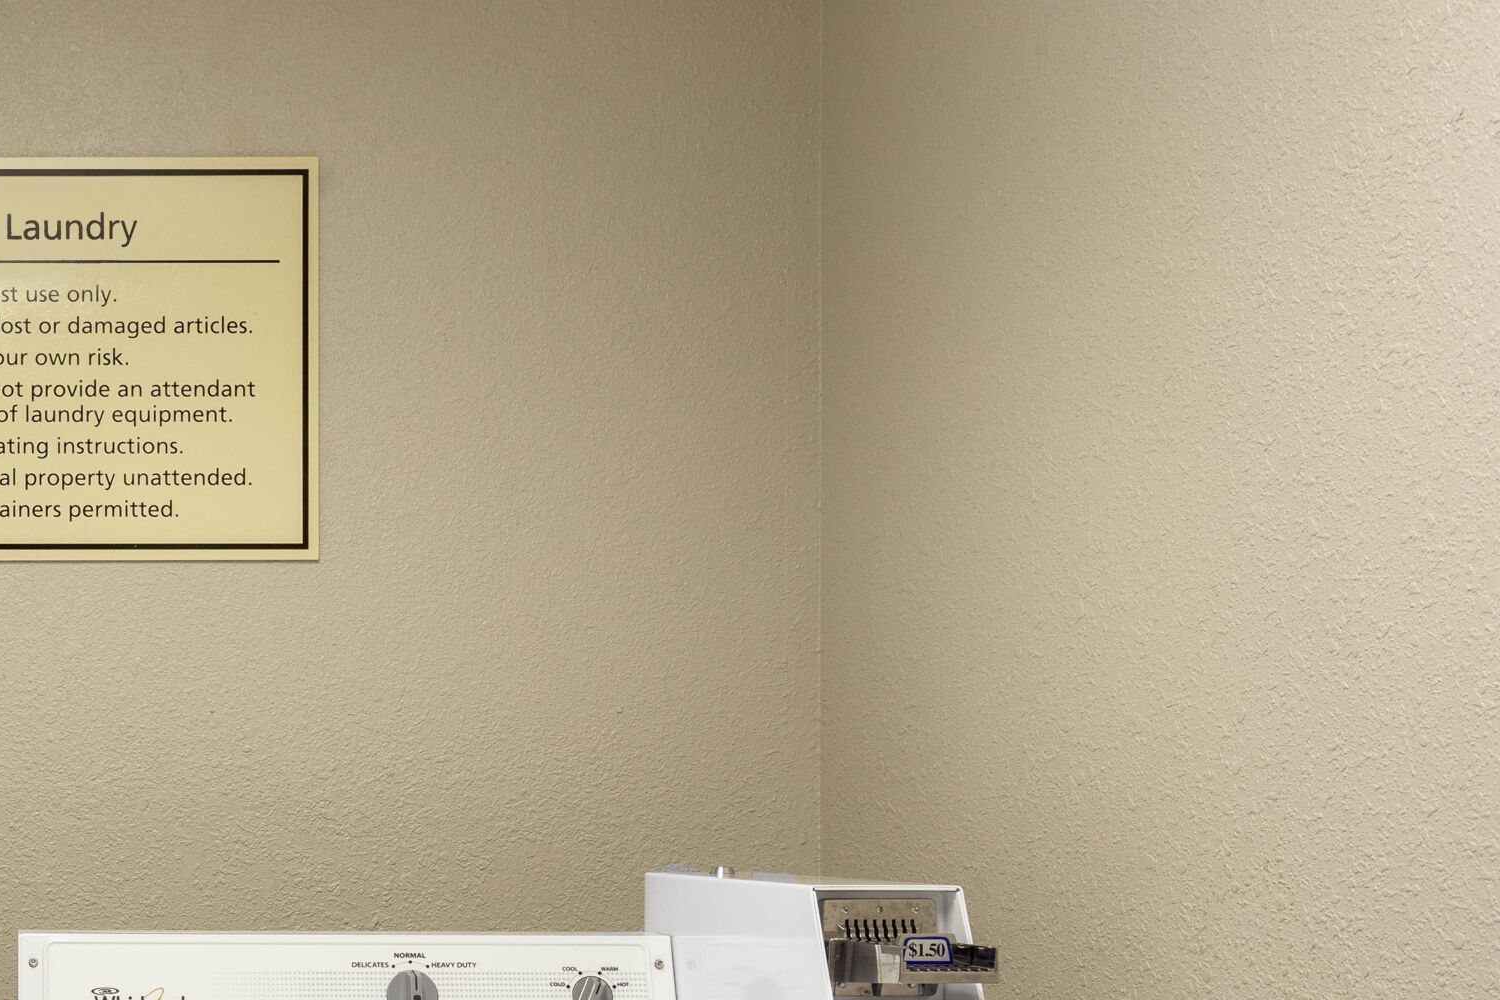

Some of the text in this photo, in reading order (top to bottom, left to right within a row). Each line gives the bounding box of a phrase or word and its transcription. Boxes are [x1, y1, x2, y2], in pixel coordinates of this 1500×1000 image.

[6, 211, 138, 248] Laundry
[25, 289, 60, 303] use
[66, 283, 117, 308] only.
[38, 320, 61, 335] or
[67, 315, 166, 340] damaged
[173, 315, 253, 335] articles.
[34, 352, 80, 366] own
[88, 346, 130, 367] risk.
[30, 378, 111, 403] provide
[117, 383, 143, 398] an
[150, 378, 256, 398] attendant
[25, 403, 105, 428] laundry
[111, 404, 233, 428] equipment.
[56, 436, 184, 455] instructions.
[24, 469, 116, 492] property
[123, 466, 253, 487] unattended.
[68, 498, 179, 523] permitted.
[908, 942, 946, 958] $1.50
